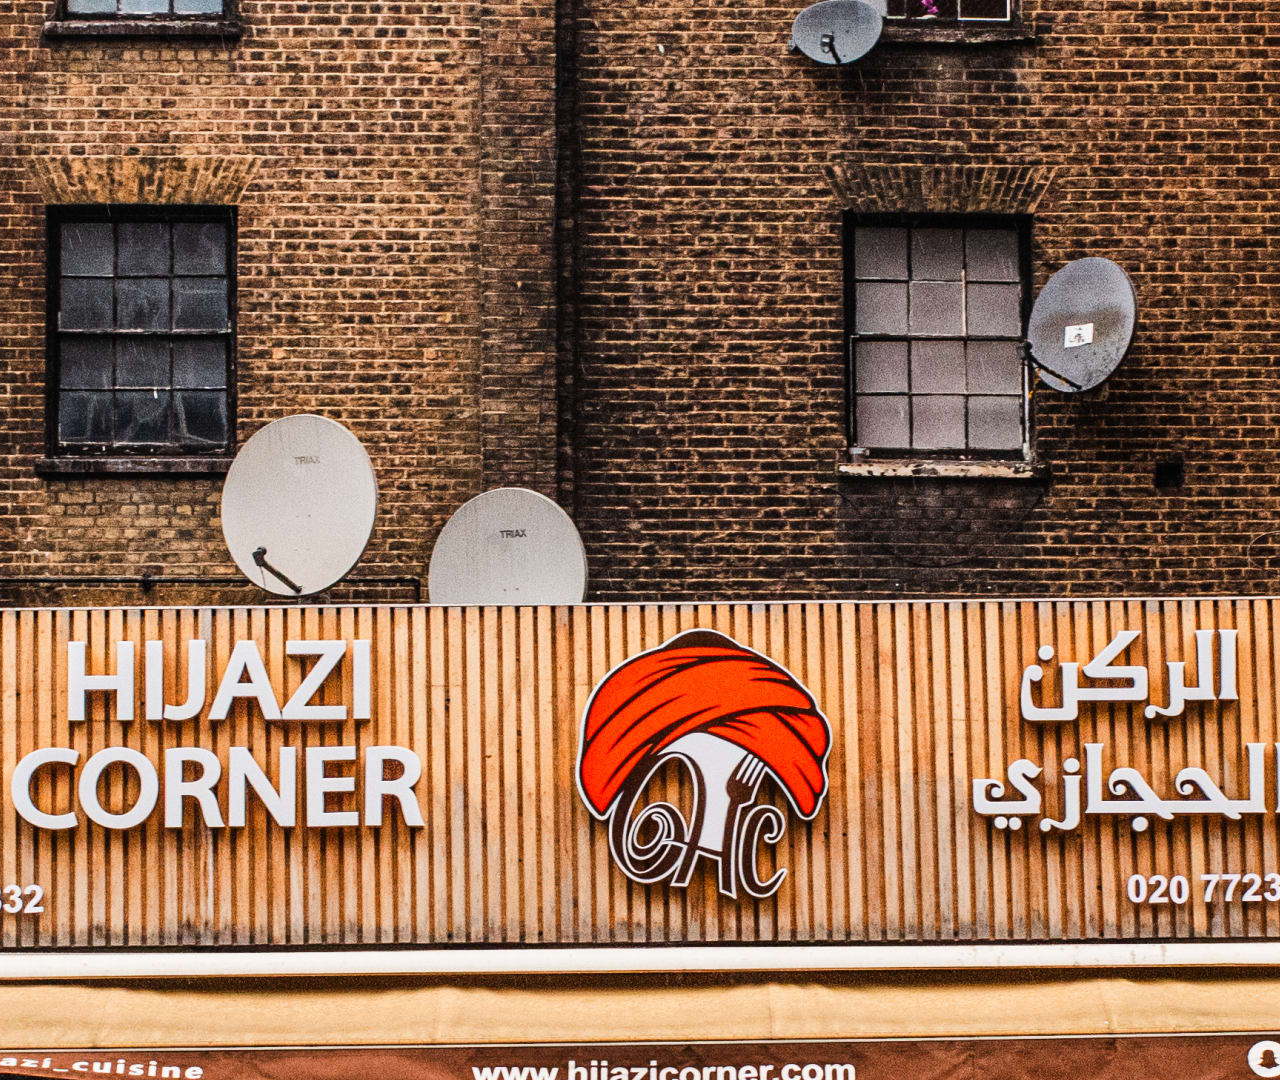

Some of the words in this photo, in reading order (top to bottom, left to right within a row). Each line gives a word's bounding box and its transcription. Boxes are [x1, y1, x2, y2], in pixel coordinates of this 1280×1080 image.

[66, 639, 372, 722] HIJAZI
[1022, 629, 1238, 721] الركن
[11, 745, 424, 831] CORNER
[1127, 874, 1189, 905] 020
